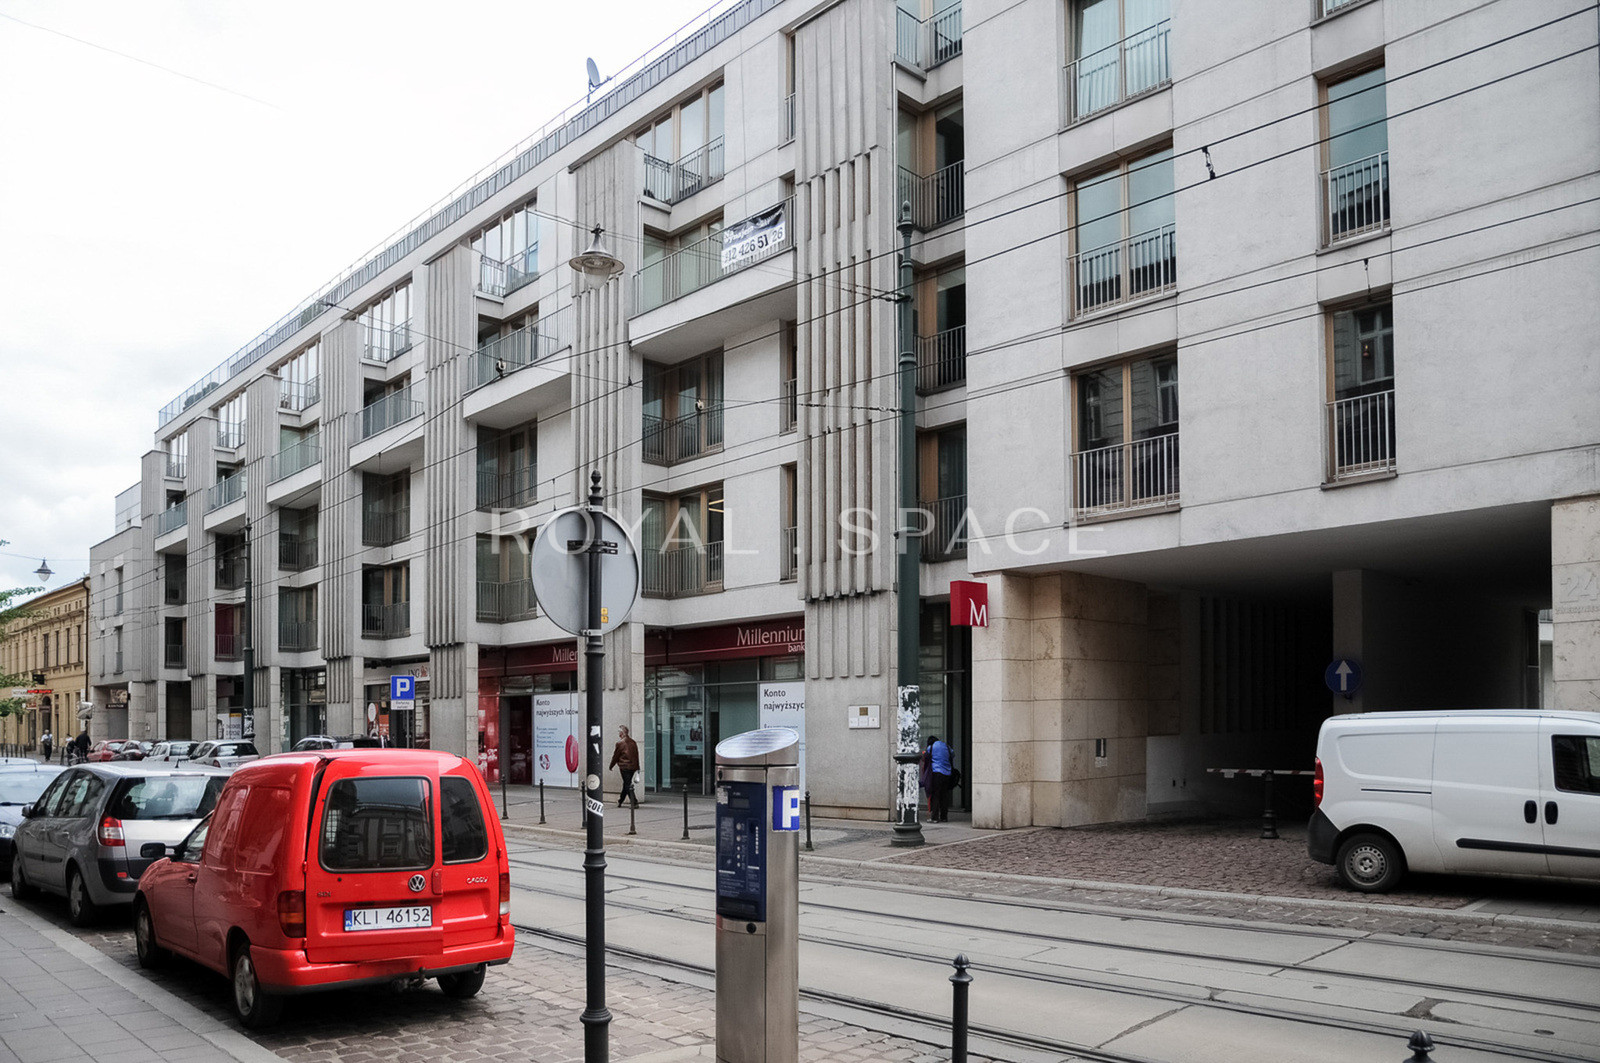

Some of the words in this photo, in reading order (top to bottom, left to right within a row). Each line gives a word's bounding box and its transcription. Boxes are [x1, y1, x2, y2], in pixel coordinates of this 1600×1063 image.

[739, 239, 755, 256] 426
[757, 234, 769, 249] 51
[772, 227, 783, 242] 26
[968, 597, 988, 627] M
[396, 678, 410, 697] P
[764, 688, 786, 698] Konto
[782, 789, 799, 828] P
[353, 910, 379, 926] KLI
[386, 908, 430, 923] 46152
